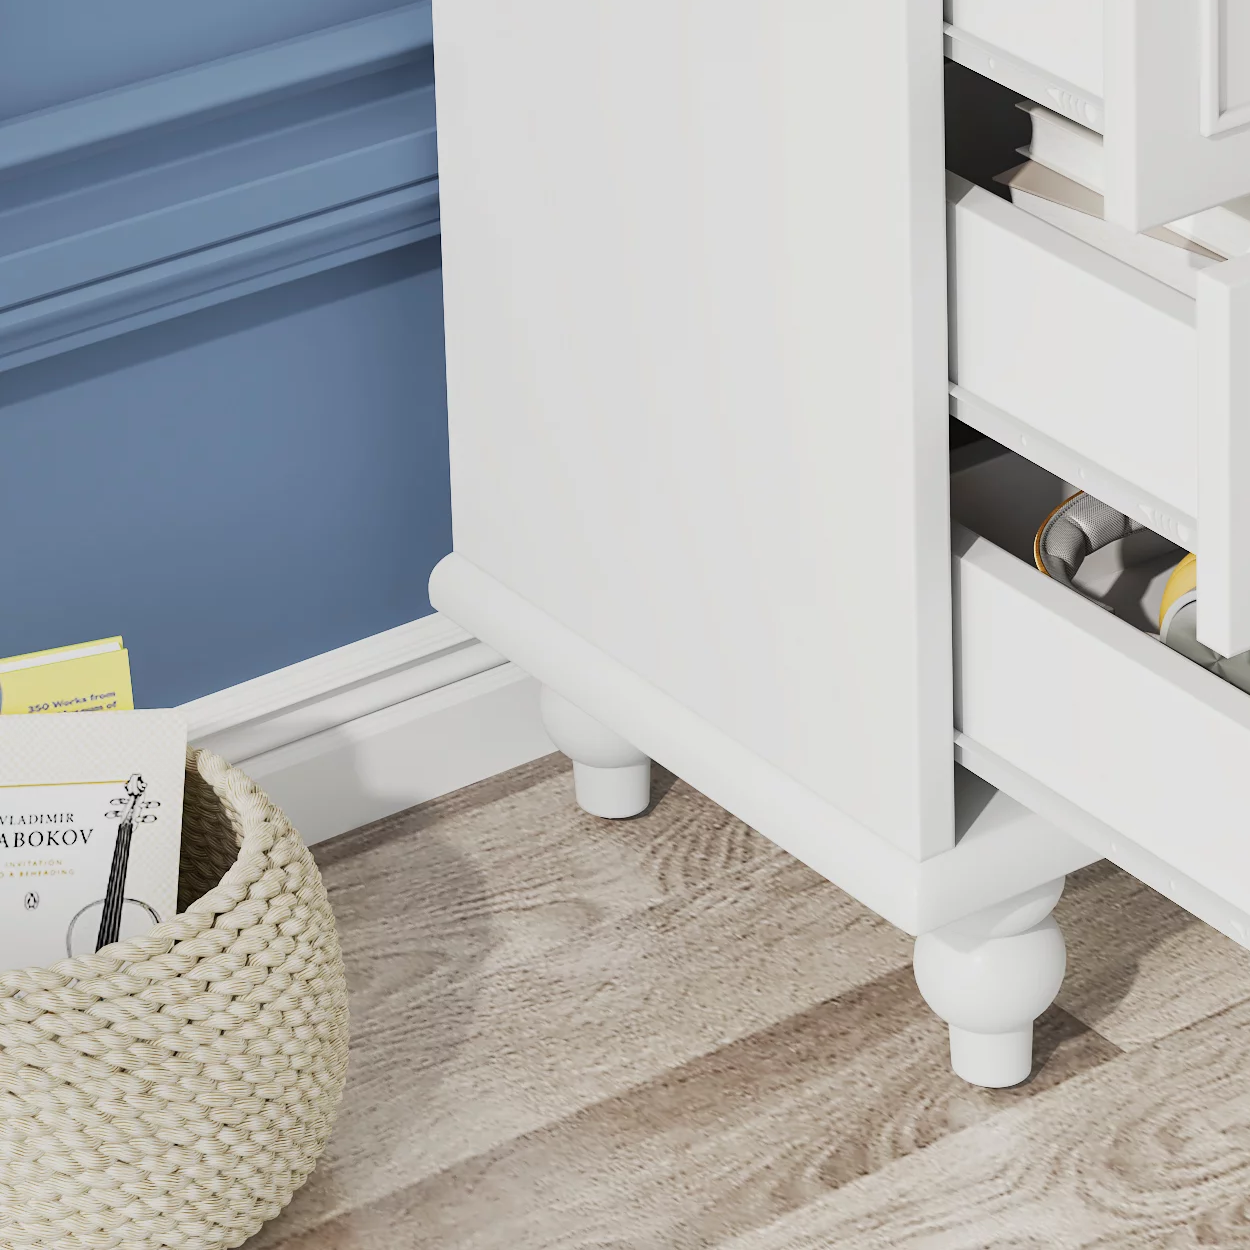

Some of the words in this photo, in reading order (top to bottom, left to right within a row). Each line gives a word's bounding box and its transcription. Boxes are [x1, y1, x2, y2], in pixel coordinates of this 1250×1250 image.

[27, 703, 50, 714] 350
[52, 697, 87, 709] Works
[90, 691, 116, 701] from
[5, 859, 63, 868] INVITATION
